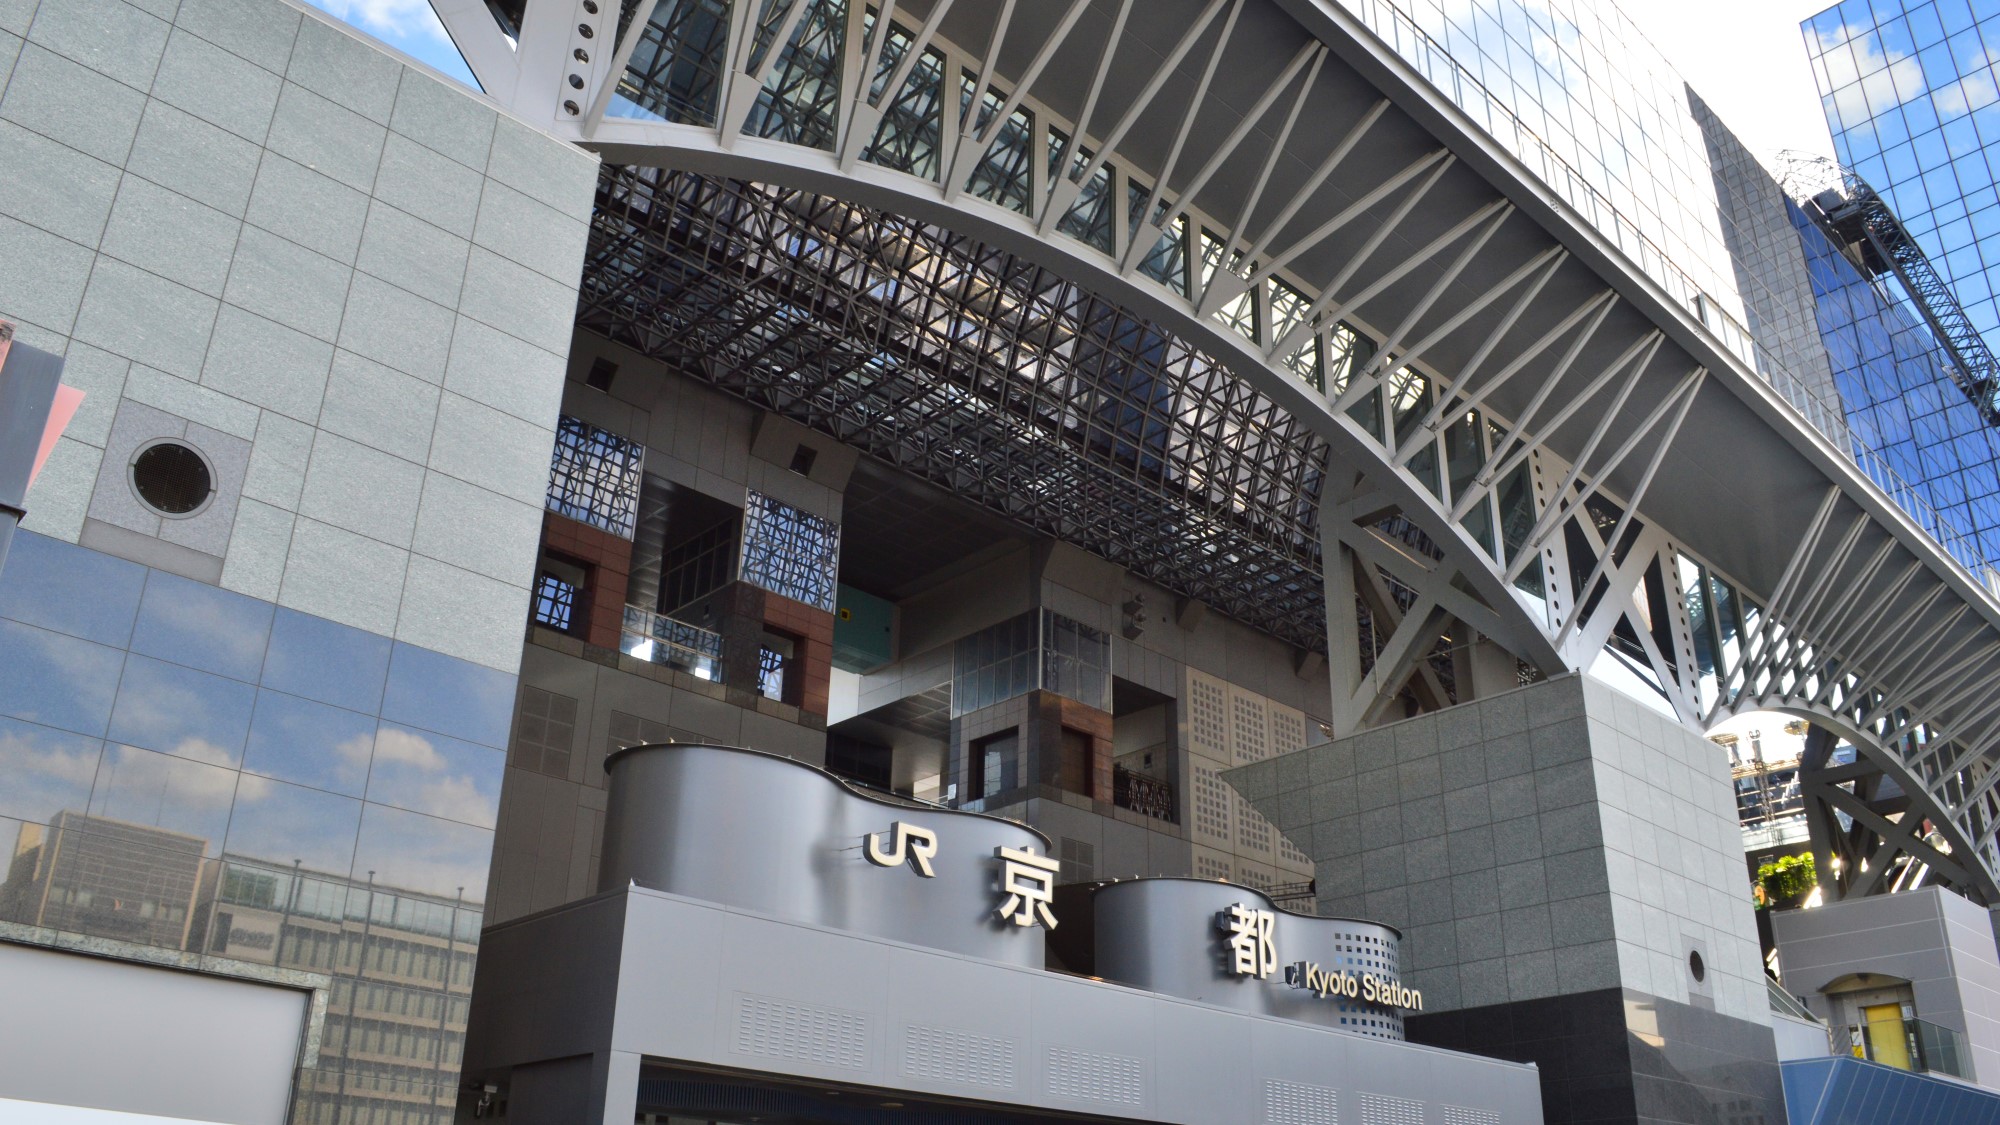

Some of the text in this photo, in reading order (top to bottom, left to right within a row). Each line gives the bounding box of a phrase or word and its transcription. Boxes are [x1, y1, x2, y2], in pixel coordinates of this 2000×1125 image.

[866, 821, 938, 878] JR
[1305, 961, 1423, 1010] Kyoto Station
